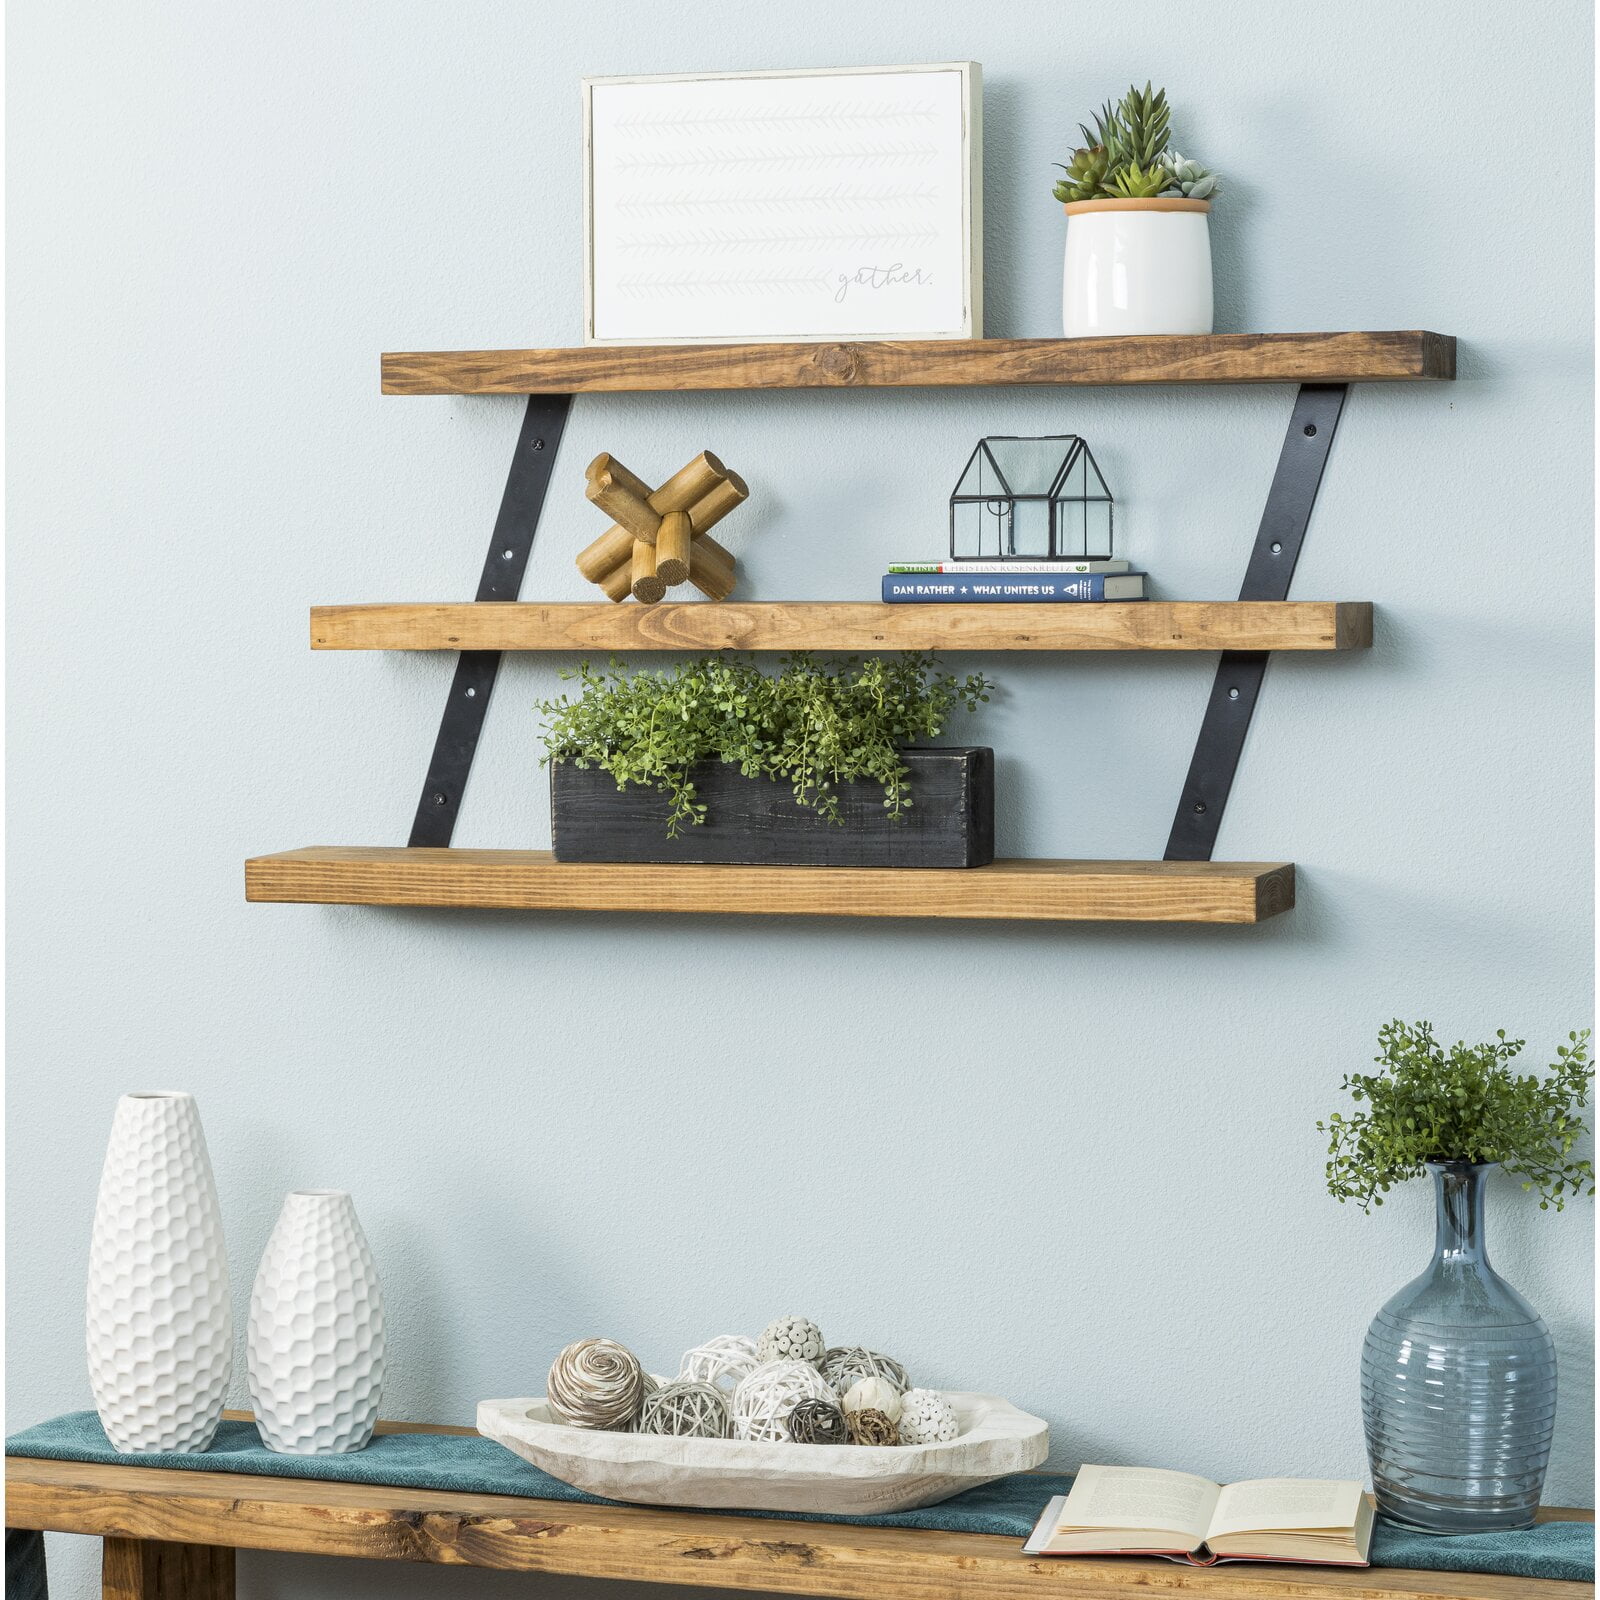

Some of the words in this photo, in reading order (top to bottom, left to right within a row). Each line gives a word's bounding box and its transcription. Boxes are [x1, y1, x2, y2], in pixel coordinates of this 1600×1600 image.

[834, 262, 934, 304] gather.
[892, 585, 914, 595] DAN
[916, 585, 955, 595] RATHER
[972, 585, 1002, 595] WHAT
[1003, 585, 1039, 595] UNITES
[1041, 585, 1055, 595] US
